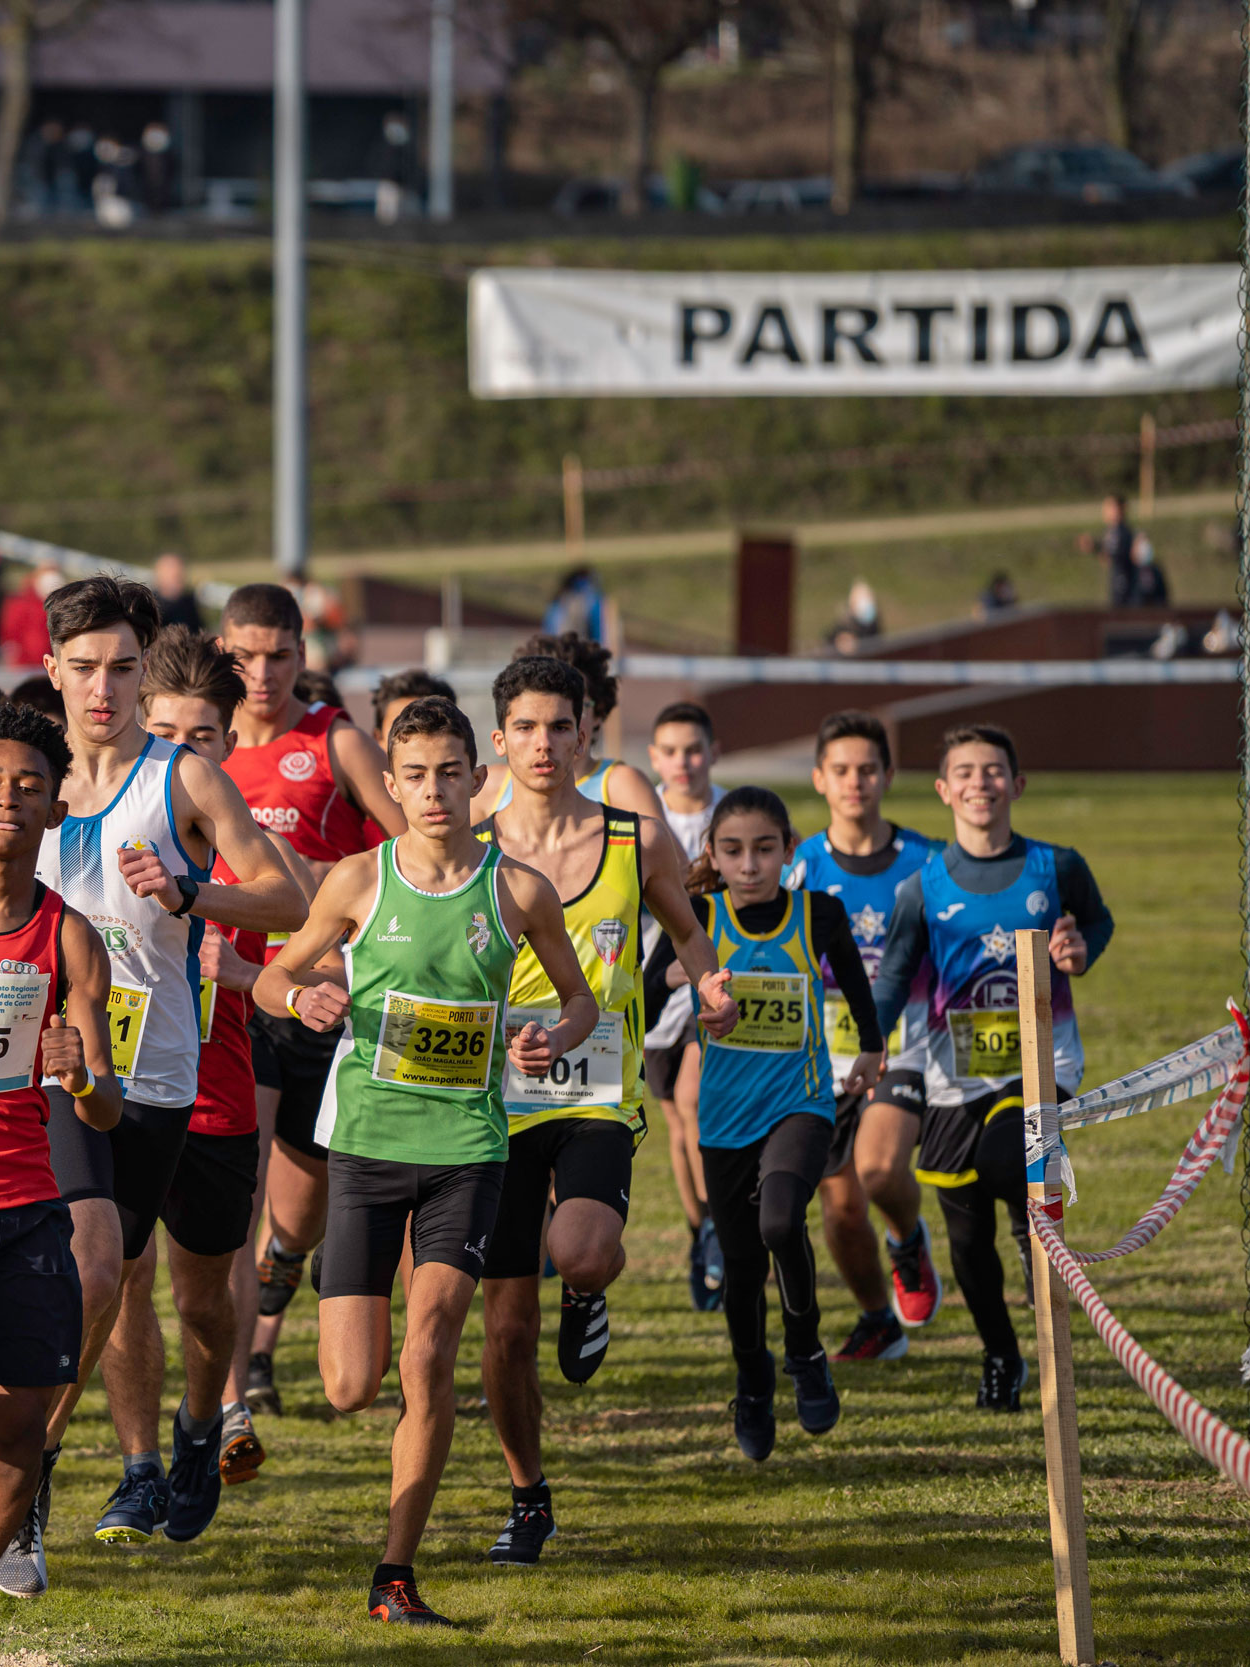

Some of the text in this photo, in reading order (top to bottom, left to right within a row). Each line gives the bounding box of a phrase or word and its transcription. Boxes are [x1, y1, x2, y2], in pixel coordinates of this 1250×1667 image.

[677, 297, 1152, 366] PARTIDA
[376, 933, 412, 942] Lacatoni
[762, 980, 786, 992] PORTO
[390, 999, 414, 1010] 2021
[448, 1011, 474, 1022] PORTO
[738, 998, 802, 1024] 4735
[414, 1027, 486, 1057] 3236
[402, 1072, 482, 1084] www.aaporto.net
[524, 1088, 594, 1098] GABRIEL FIGUEIREDO
